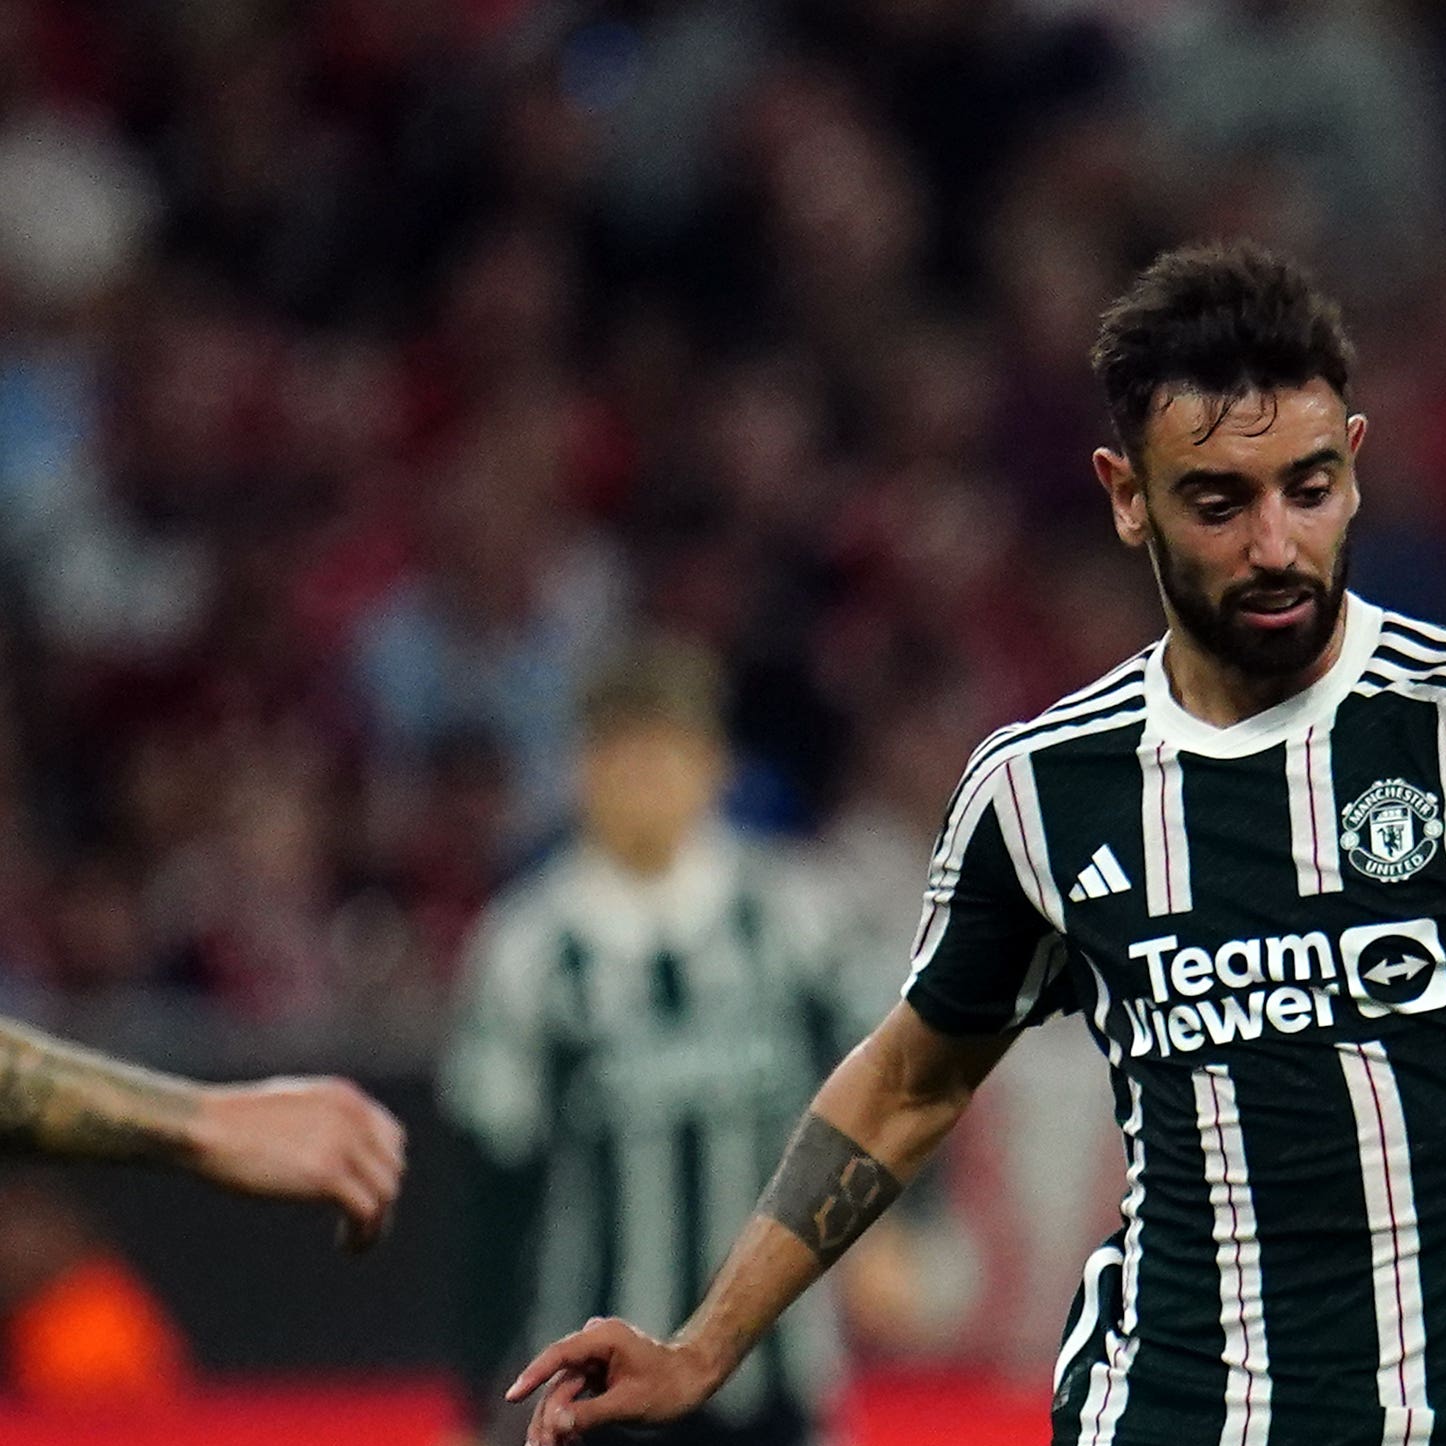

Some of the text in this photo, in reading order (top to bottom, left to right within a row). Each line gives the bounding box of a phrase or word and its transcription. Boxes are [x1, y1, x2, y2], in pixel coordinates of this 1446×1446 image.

[1349, 787, 1432, 825] MANCHESTER
[1365, 853, 1424, 875] UNITED
[1128, 930, 1337, 1004] Team
